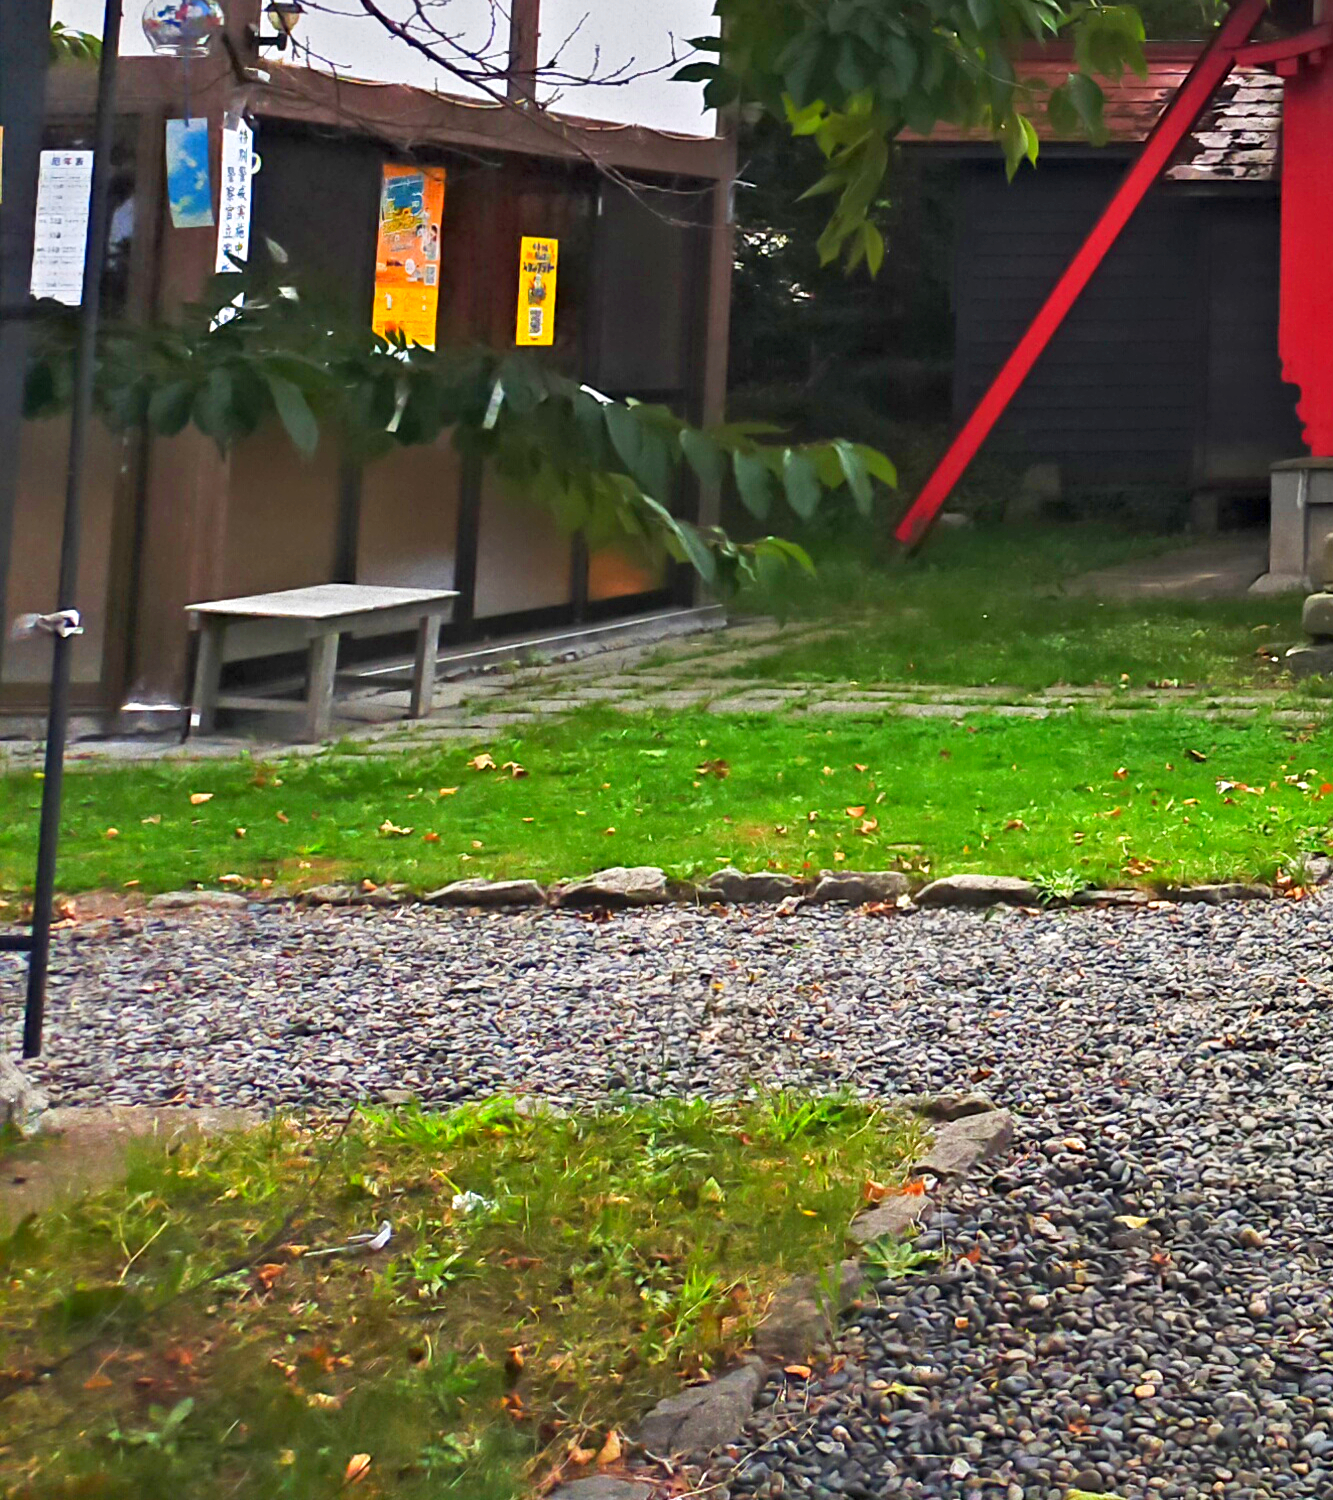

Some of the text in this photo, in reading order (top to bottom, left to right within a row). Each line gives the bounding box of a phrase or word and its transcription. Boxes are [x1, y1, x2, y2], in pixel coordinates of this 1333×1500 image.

[235, 130, 248, 253] 特別警戒実施中
